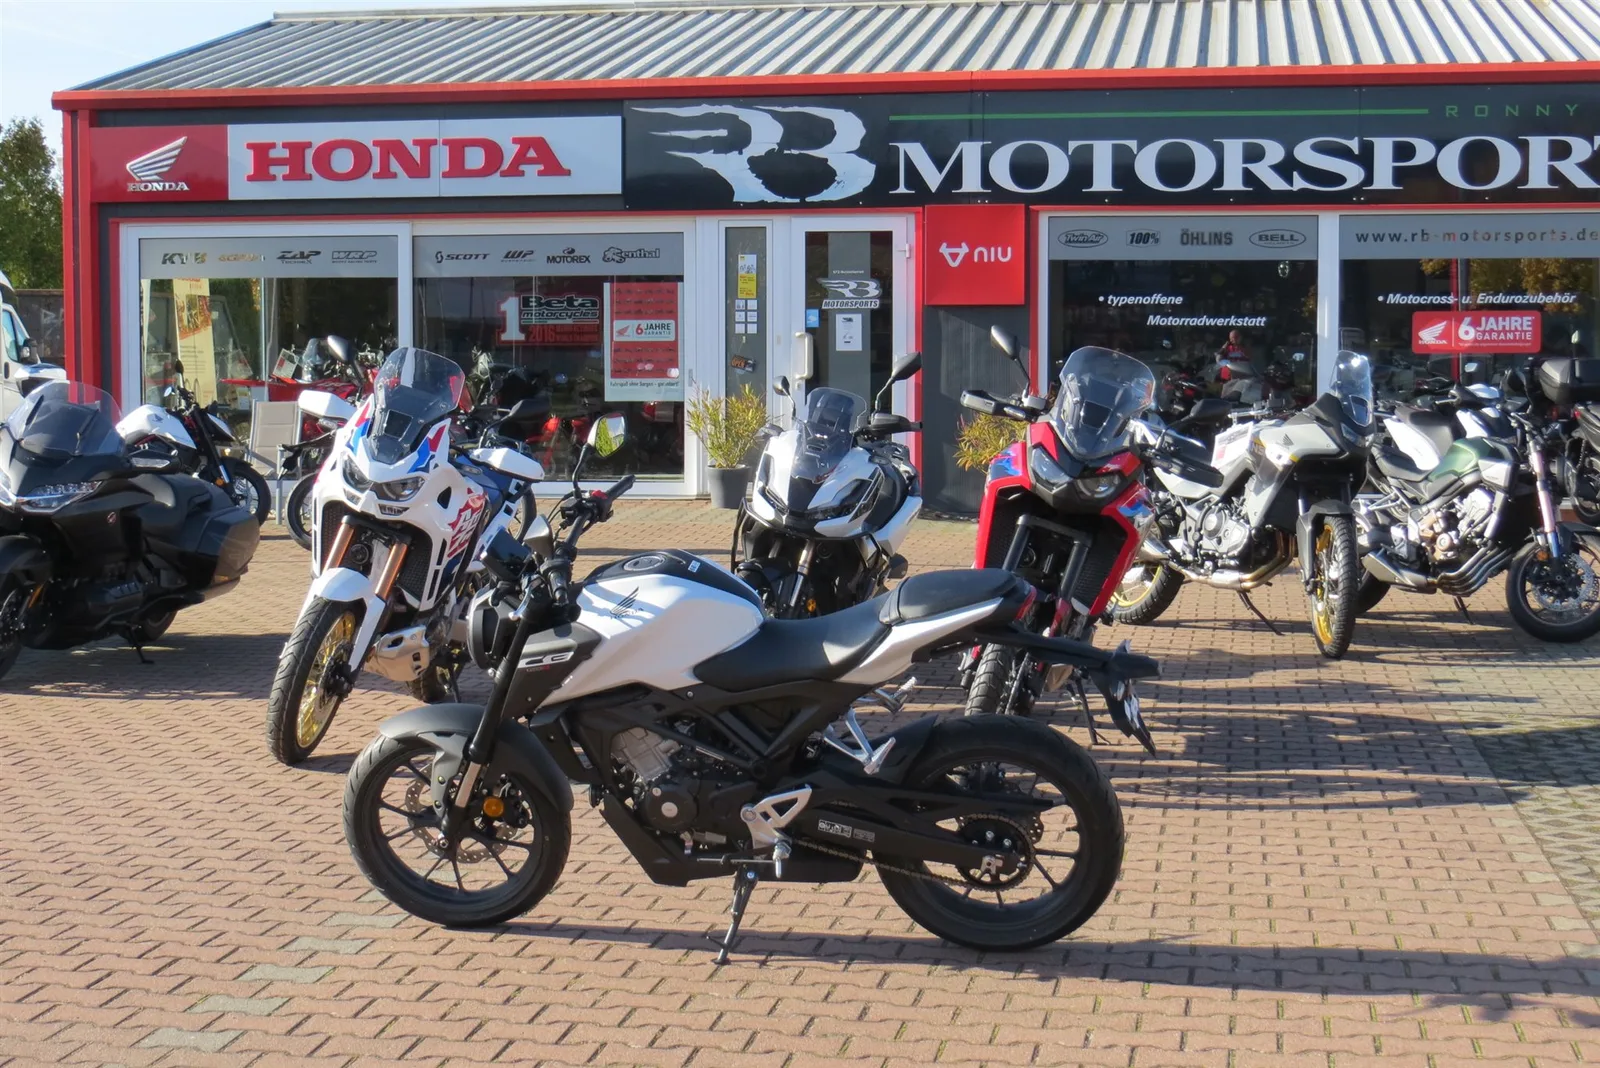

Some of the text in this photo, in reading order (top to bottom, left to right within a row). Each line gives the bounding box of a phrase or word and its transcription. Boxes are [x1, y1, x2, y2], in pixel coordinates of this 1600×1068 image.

[1445, 104, 1578, 117] RONNY
[246, 137, 570, 181] HONDA
[127, 182, 190, 191] HONDA
[1129, 232, 1159, 245] 100%
[1180, 229, 1233, 246] ÖHLINS
[1258, 234, 1299, 242] BELL
[1355, 228, 1599, 244] www.rb-motorsports.de
[276, 250, 322, 260] ZAP
[331, 250, 378, 260] WRP
[445, 253, 490, 261] SCOTT
[503, 249, 535, 259] WP
[546, 255, 591, 264] MOTOREX
[520, 294, 599, 310] Beta
[822, 299, 878, 308] MOTORSPORTS
[1107, 294, 1183, 306] typenoffene
[1386, 292, 1577, 304] Motocross- u. Endurozubehör
[500, 296, 525, 341] 1
[521, 309, 600, 319] motorcycles
[1147, 315, 1267, 327] Motorradwerkstatt
[635, 324, 644, 335] 6
[644, 323, 672, 331] JAHRE
[1458, 316, 1476, 340] 6
[1476, 332, 1532, 340] GARANTIE
